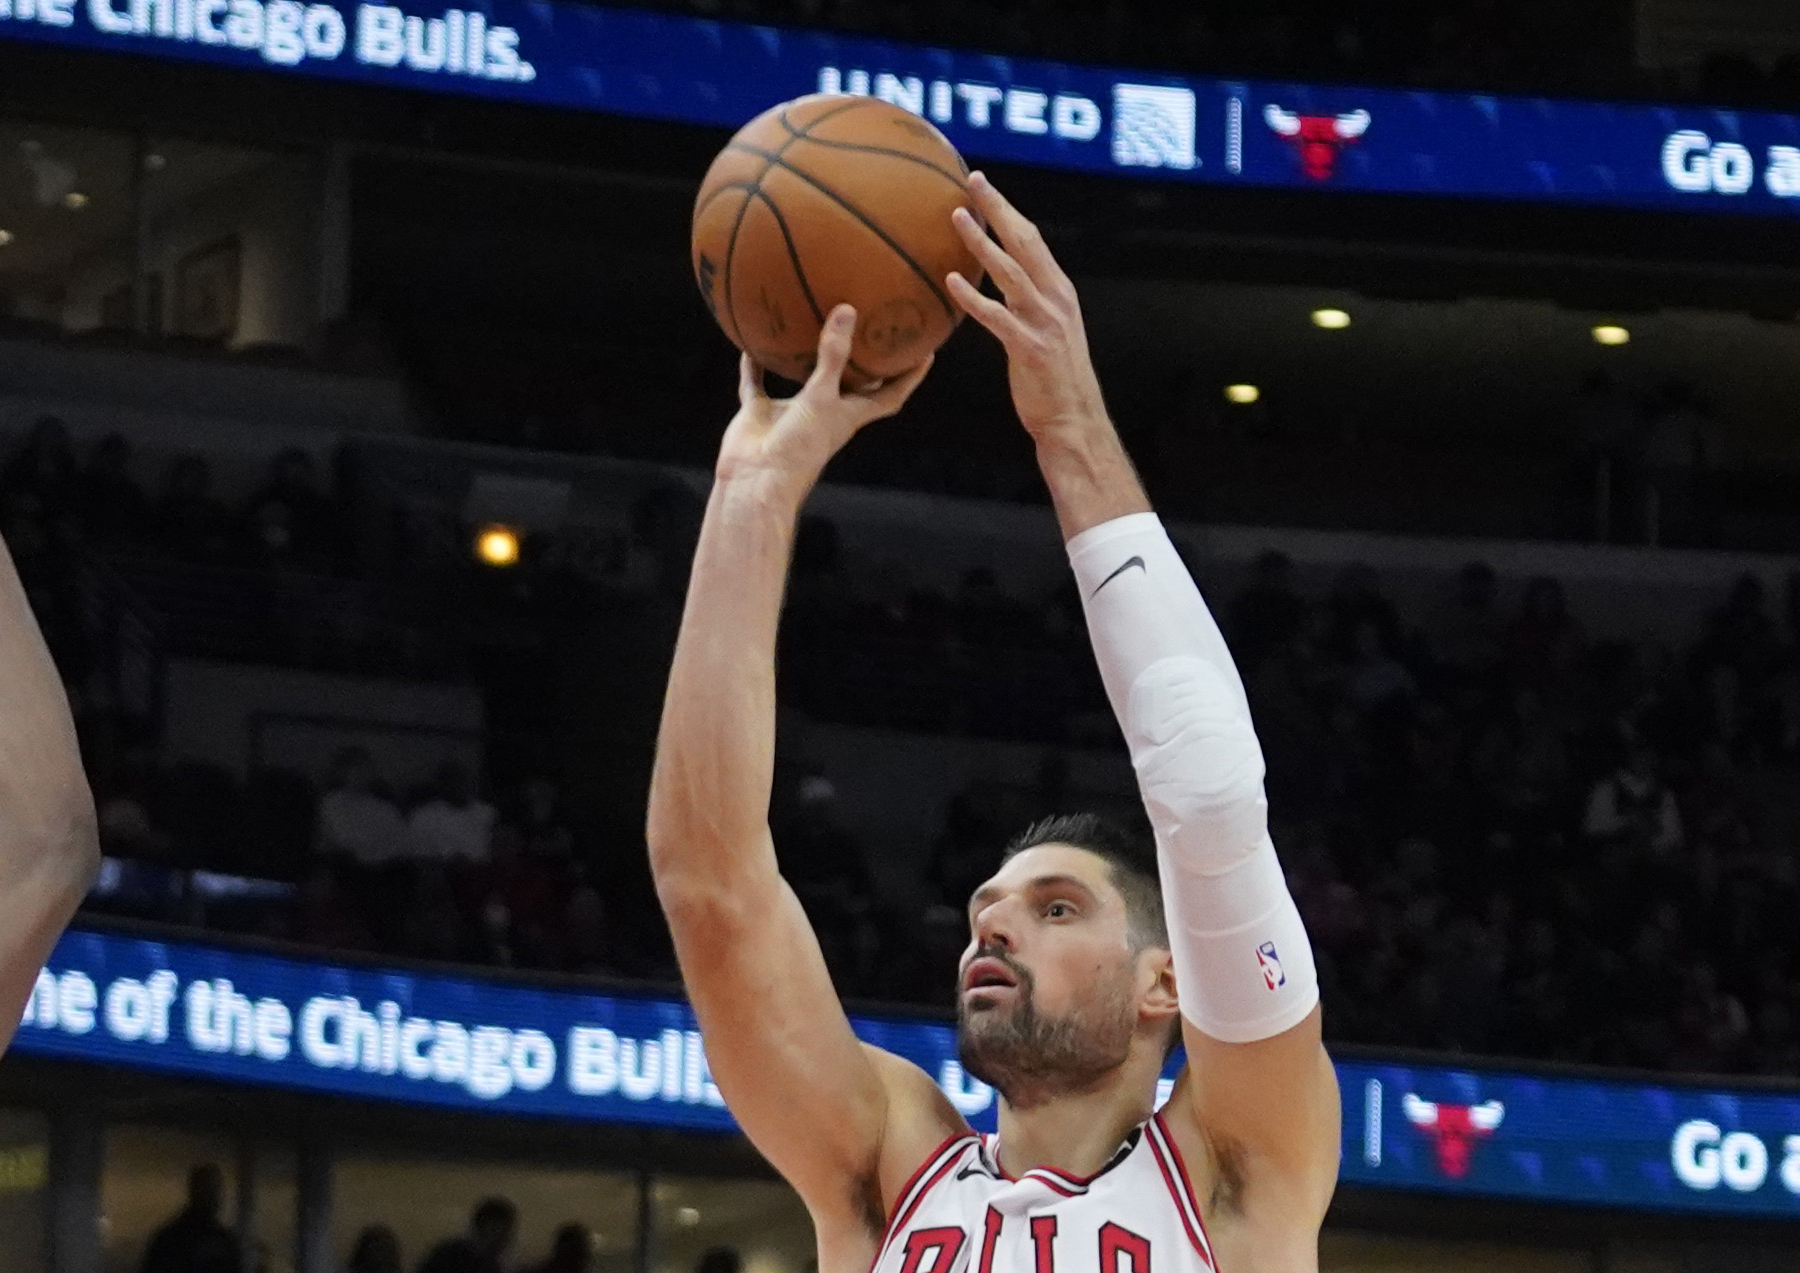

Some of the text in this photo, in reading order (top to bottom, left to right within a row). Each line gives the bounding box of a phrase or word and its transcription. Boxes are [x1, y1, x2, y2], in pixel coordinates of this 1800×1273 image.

[357, 4, 536, 82] Bulls.
[1662, 129, 1754, 194] Go
[105, 968, 179, 1043] of
[186, 978, 292, 1061] the
[301, 995, 557, 1099] Chicago
[1671, 1118, 1769, 1192] Go
